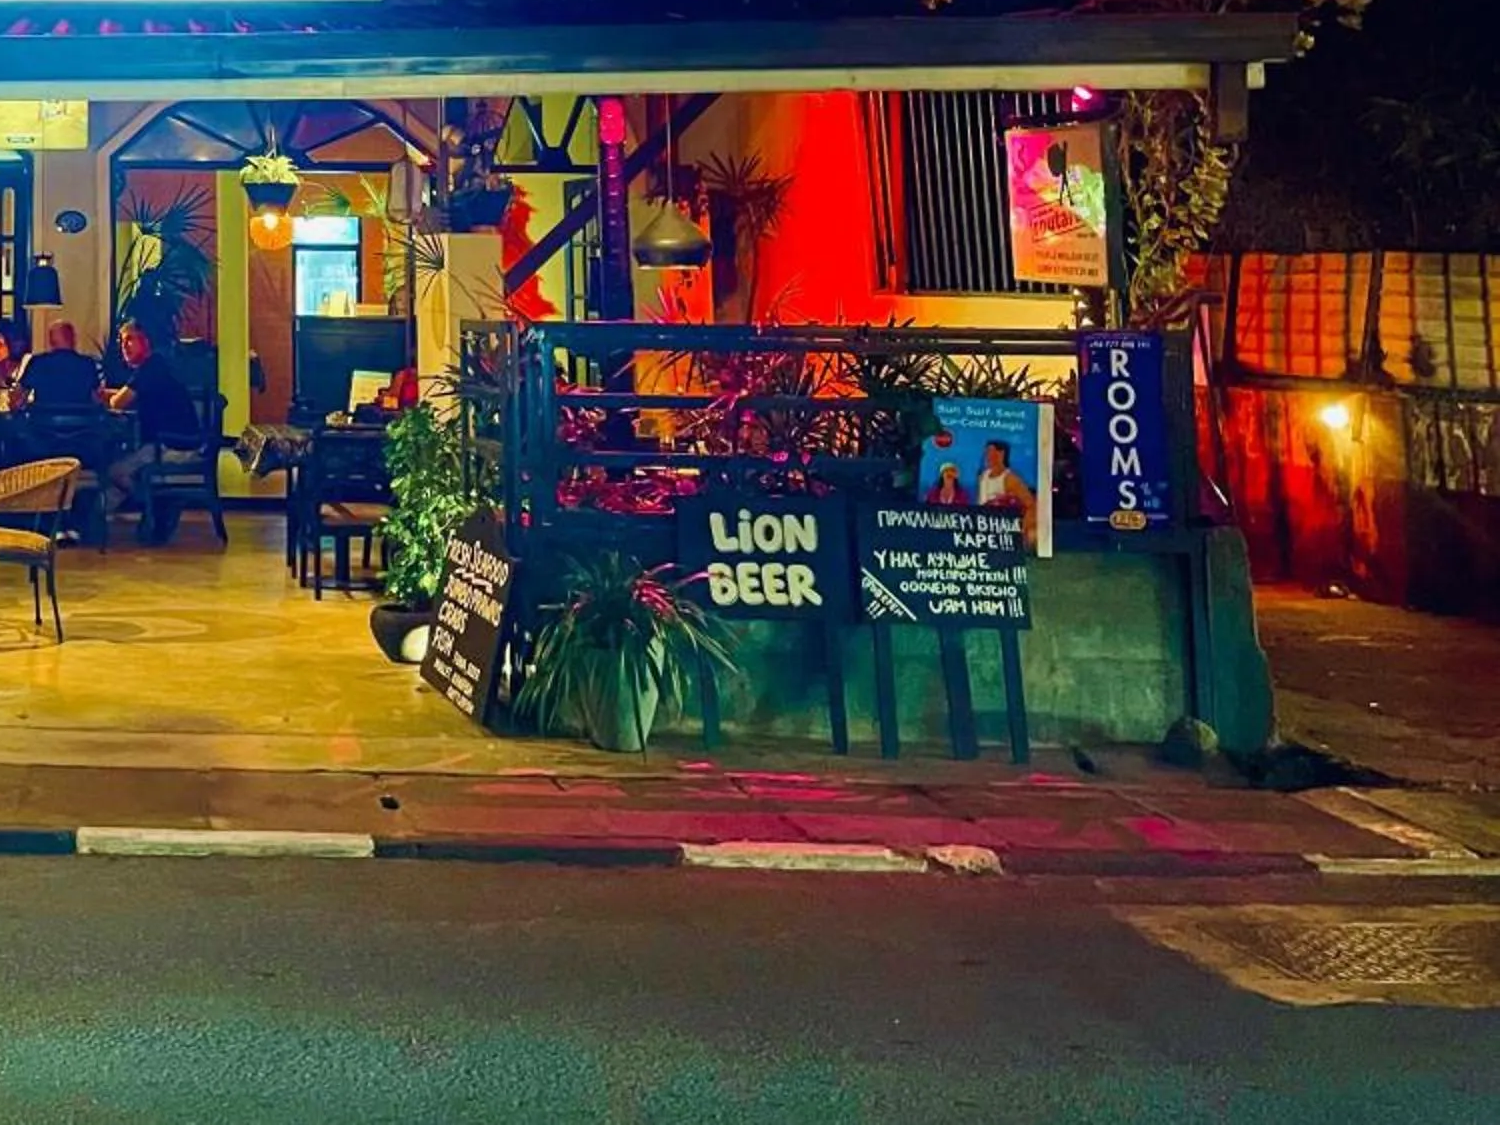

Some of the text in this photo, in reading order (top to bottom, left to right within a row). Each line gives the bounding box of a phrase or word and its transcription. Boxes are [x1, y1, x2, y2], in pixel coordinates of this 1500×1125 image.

[1107, 348, 1142, 510] ROOMS
[889, 551, 922, 569] НАС
[707, 562, 823, 606] BEER
